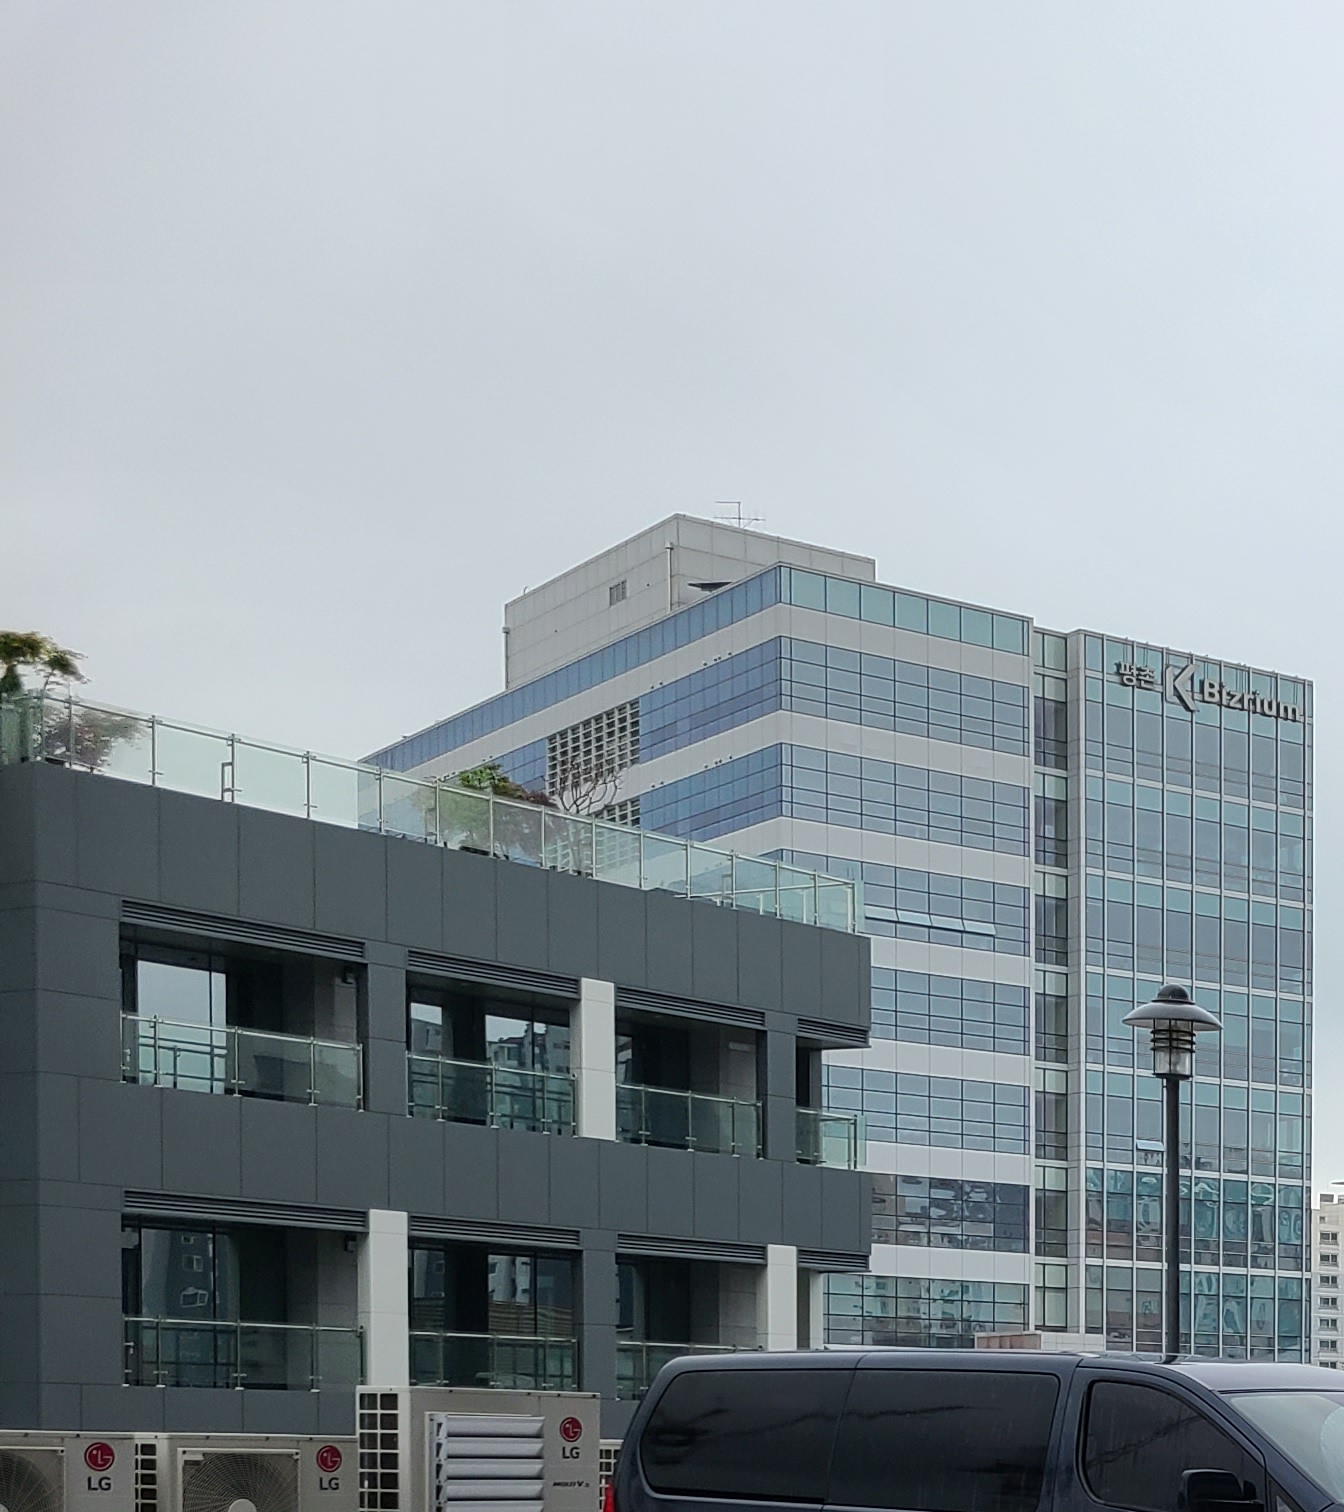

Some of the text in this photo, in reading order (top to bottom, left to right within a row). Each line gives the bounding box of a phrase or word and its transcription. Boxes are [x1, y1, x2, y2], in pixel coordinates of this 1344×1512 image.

[1116, 661, 1156, 689] 평촌
[1202, 678, 1300, 722] Bizrium
[562, 1446, 581, 1460] LG
[87, 1477, 112, 1491] LG
[319, 1477, 340, 1491] LG
